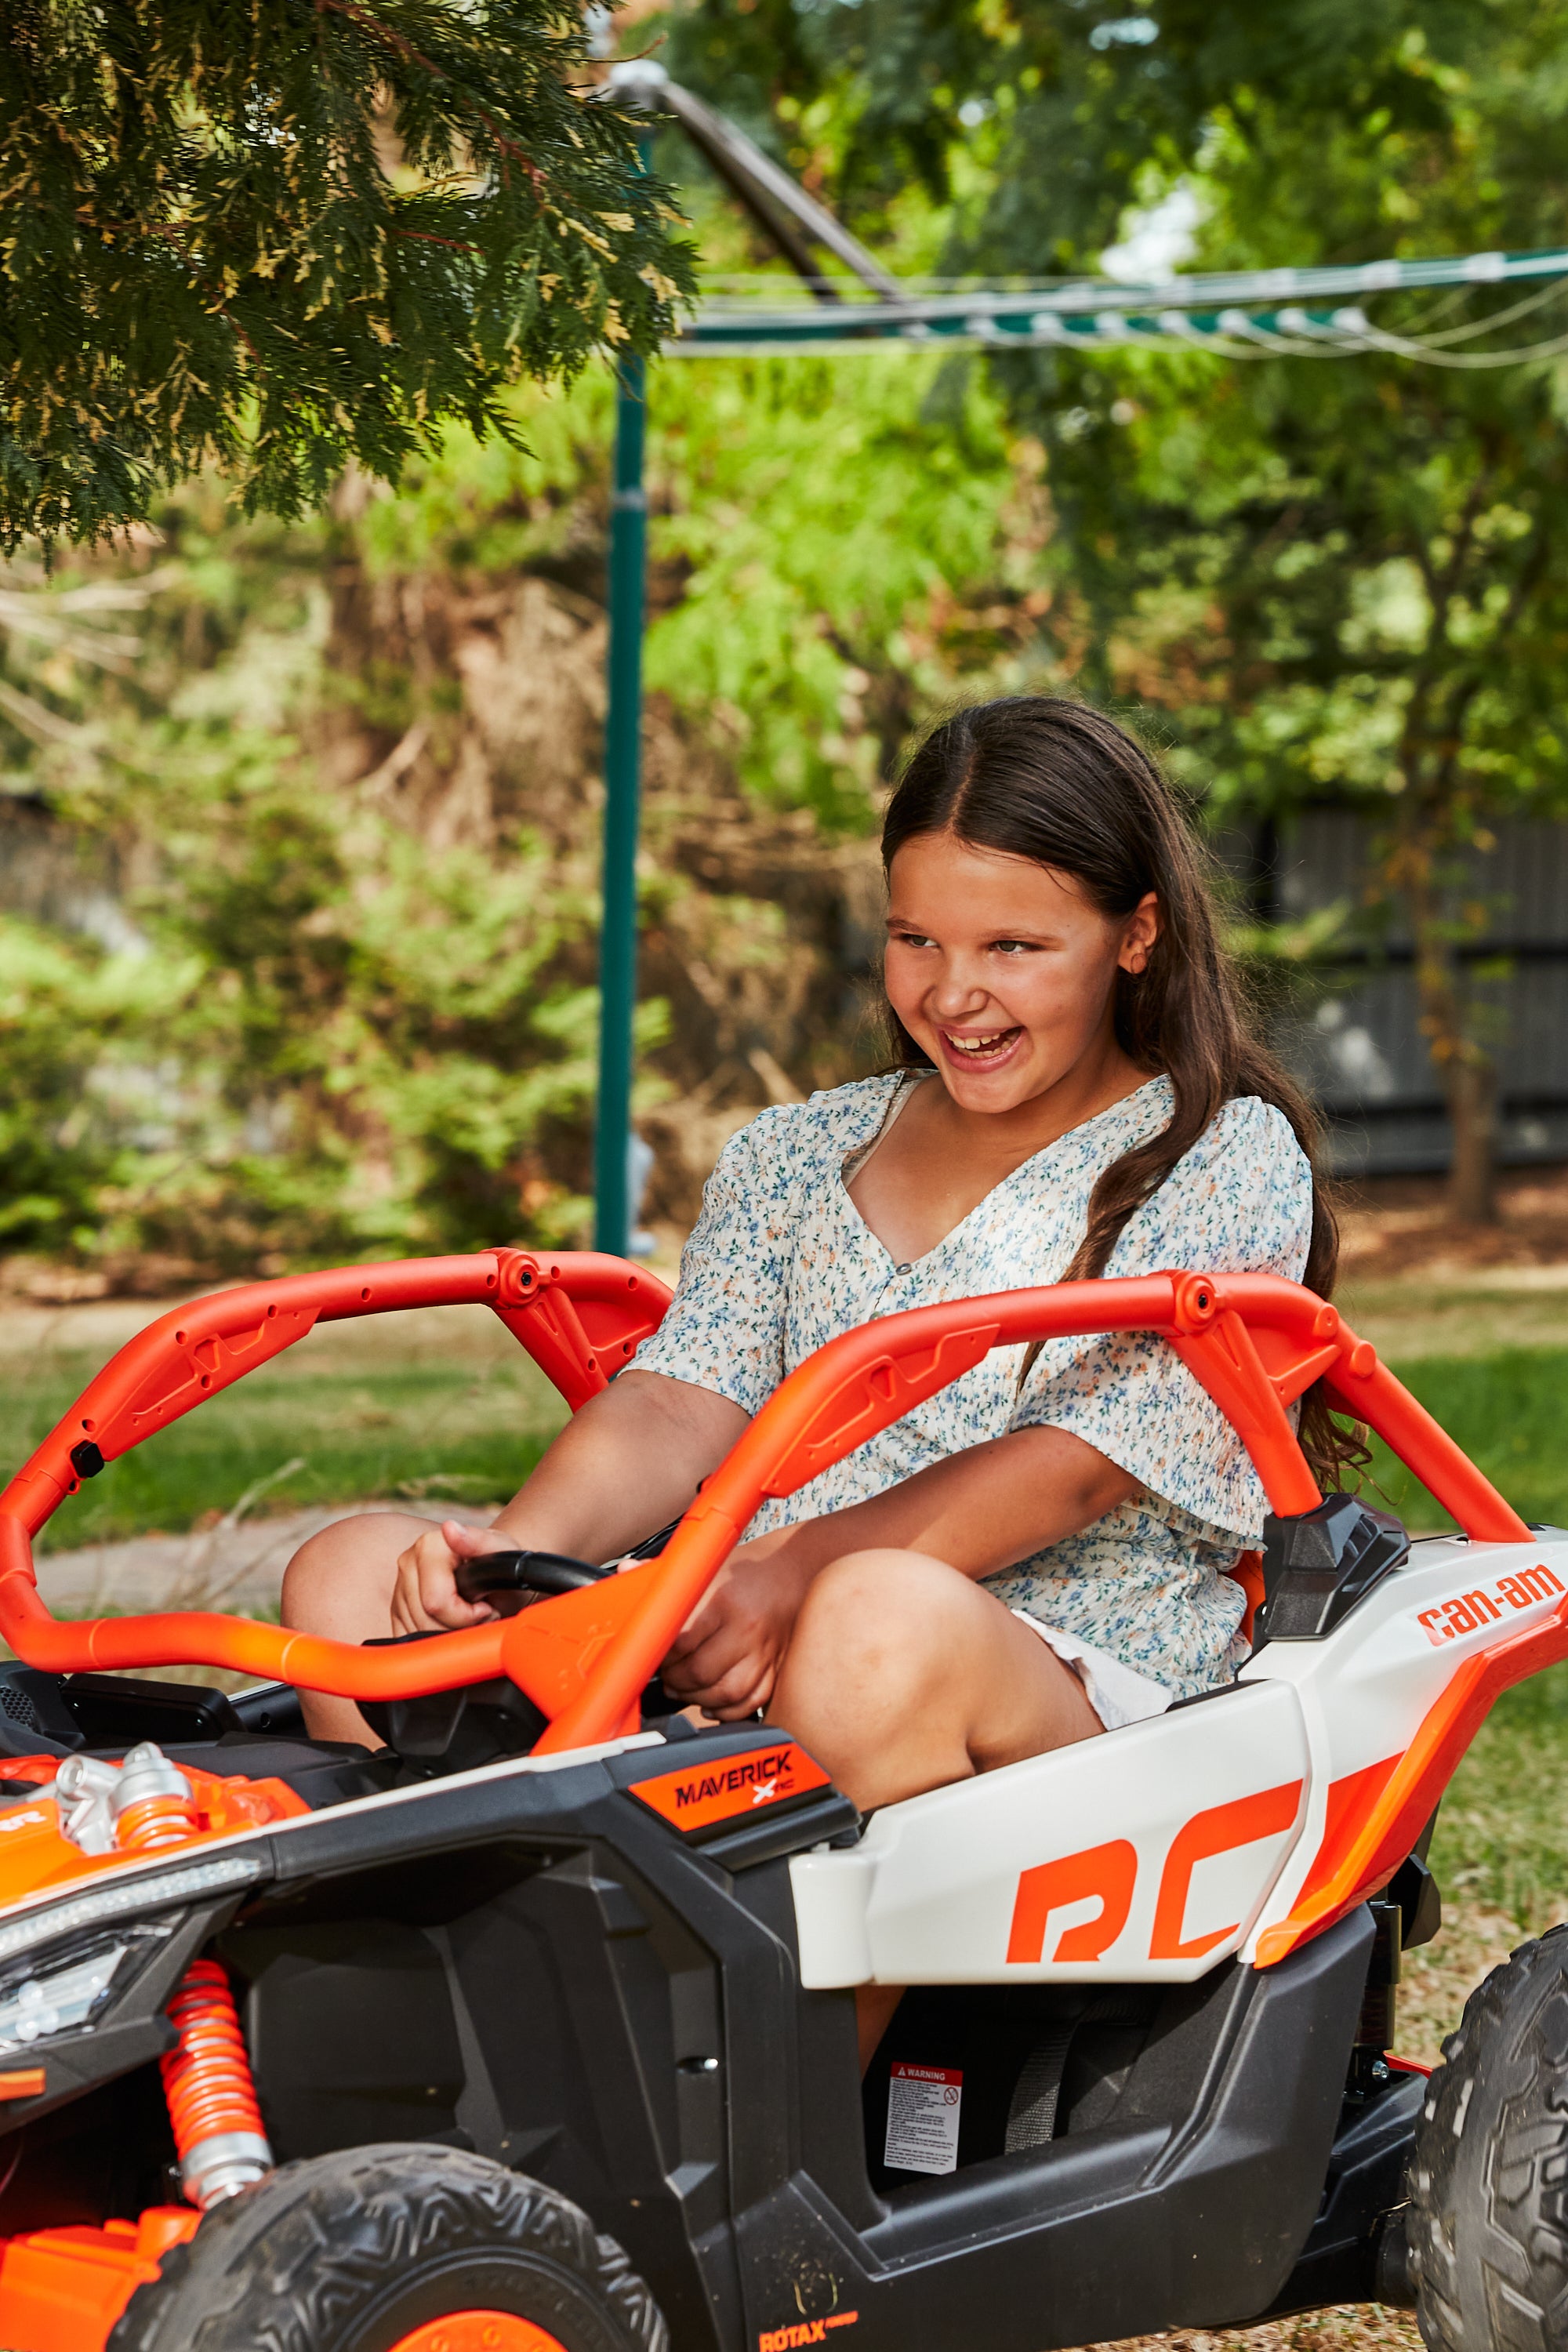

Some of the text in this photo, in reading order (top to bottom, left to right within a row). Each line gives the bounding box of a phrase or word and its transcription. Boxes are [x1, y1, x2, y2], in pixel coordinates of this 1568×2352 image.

[675, 1750, 793, 1809] MAVERICK
[907, 2068, 946, 2082] WARNING
[759, 2318, 826, 2352] ROTAX
